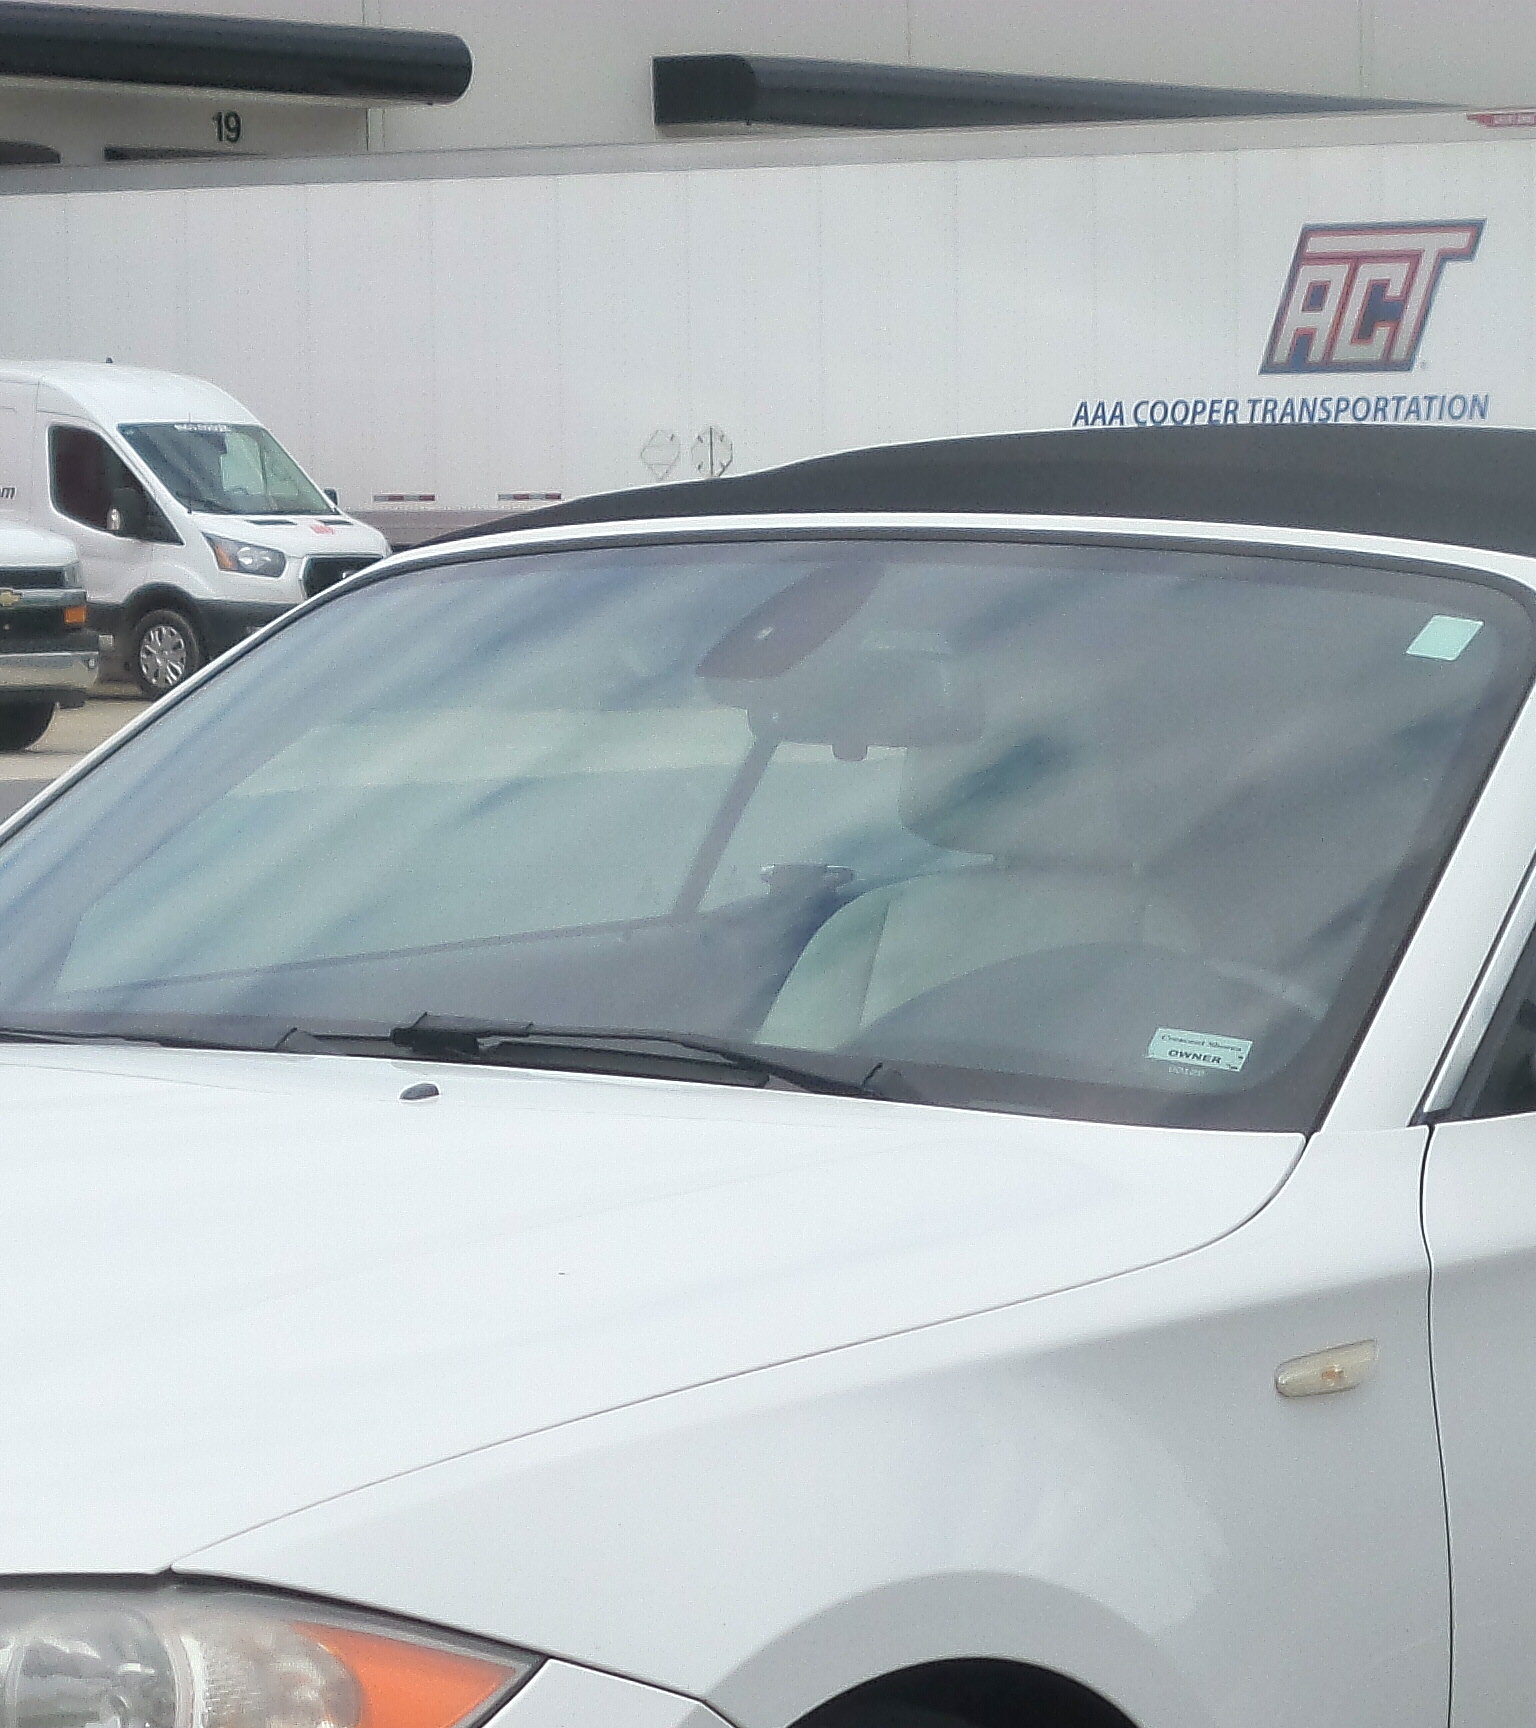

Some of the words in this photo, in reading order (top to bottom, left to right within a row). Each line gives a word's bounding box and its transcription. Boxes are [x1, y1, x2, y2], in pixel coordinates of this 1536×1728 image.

[213, 111, 241, 143] 19
[1259, 218, 1488, 375] ACT
[1071, 400, 1125, 426] AAA
[1133, 399, 1239, 425] COOPER
[1247, 393, 1490, 424] TRANSPORTATION
[1168, 1049, 1222, 1065] OWNER
